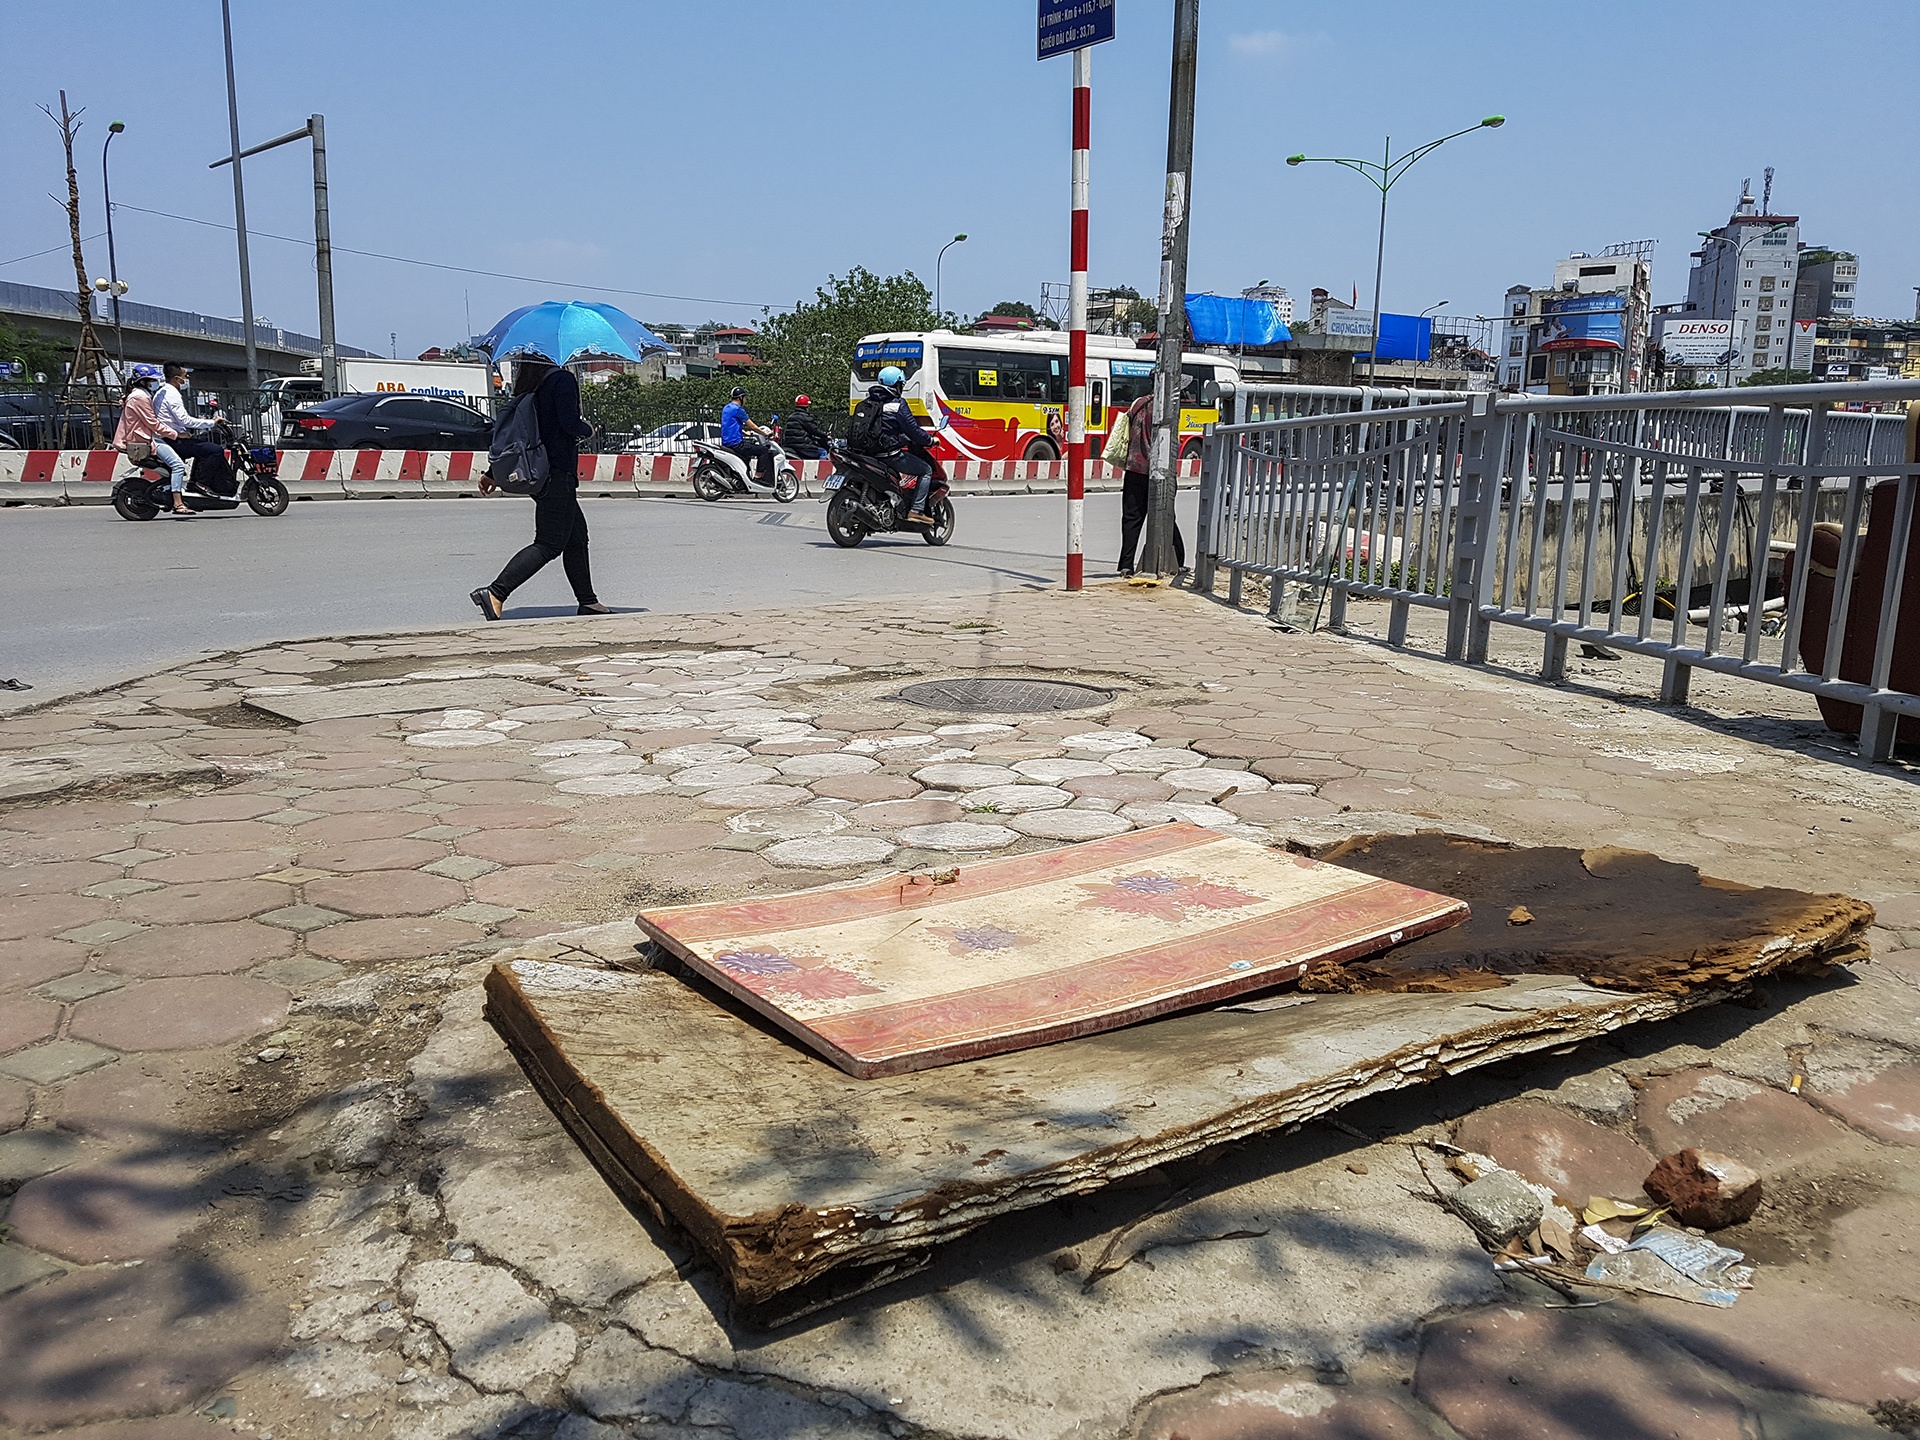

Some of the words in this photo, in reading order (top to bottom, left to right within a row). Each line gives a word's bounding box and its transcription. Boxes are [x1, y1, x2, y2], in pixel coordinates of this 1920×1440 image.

[1064, 8, 1073, 21] Km
[1080, 24, 1095, 38] 33,7m
[1679, 323, 1729, 334] DENSO
[376, 382, 406, 392] ABA
